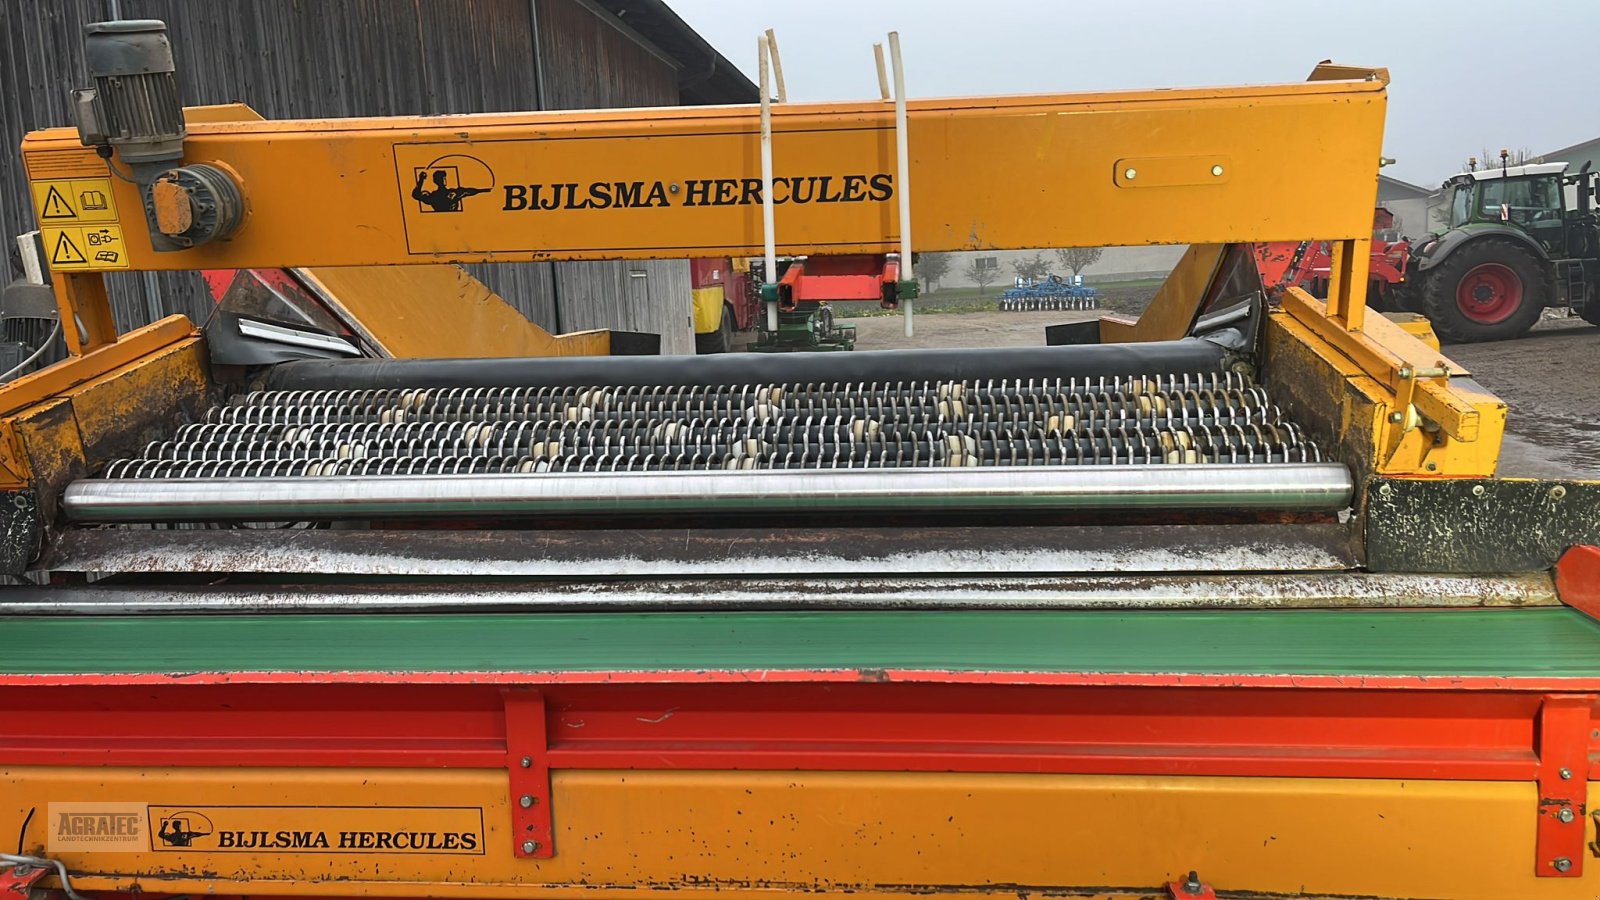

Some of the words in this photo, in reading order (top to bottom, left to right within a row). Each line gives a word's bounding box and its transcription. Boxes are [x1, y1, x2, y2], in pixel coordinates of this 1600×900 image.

[502, 181, 671, 211] BIJLSMA
[682, 174, 894, 206] HERCULES
[218, 831, 330, 848] BIJLSMA
[338, 832, 477, 850] HERCULES
